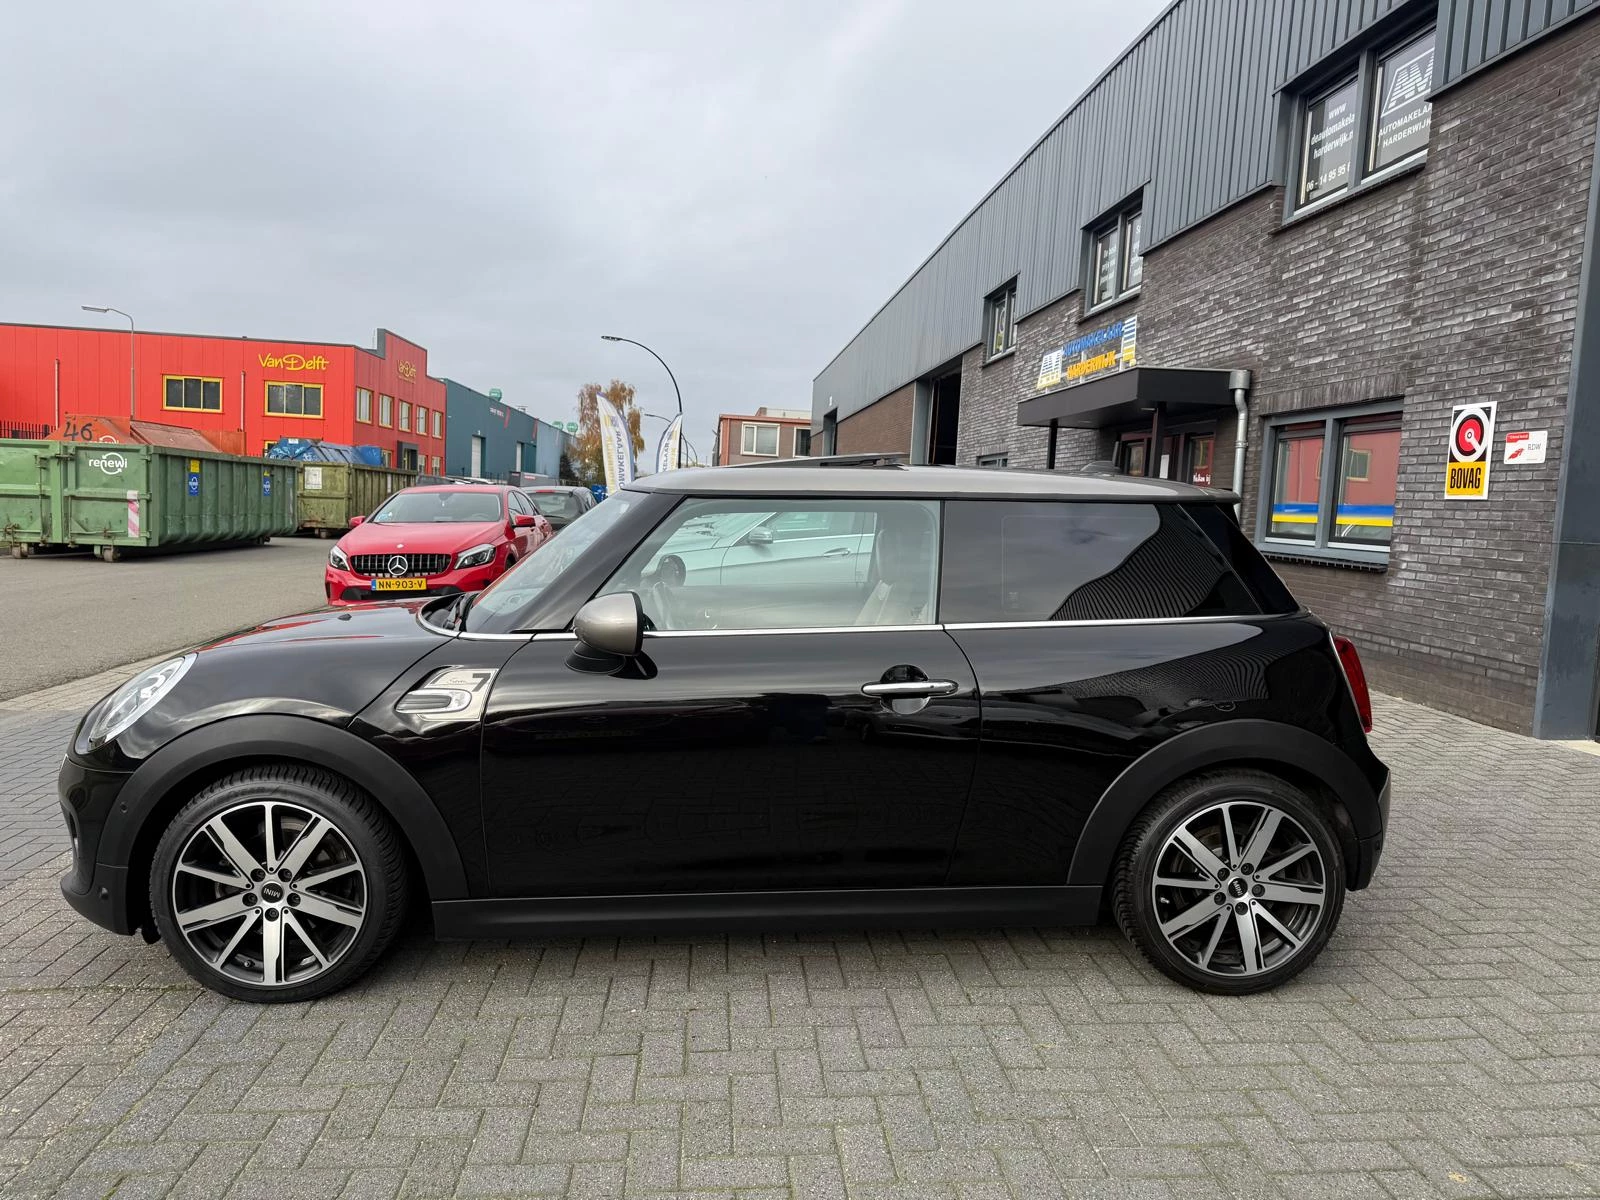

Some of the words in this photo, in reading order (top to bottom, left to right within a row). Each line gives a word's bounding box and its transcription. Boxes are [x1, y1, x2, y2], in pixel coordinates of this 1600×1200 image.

[1328, 102, 1347, 120] www
[1320, 172, 1328, 185] 14
[1328, 166, 1337, 179] 95
[1337, 162, 1346, 175] 95
[63, 421, 93, 441] 46
[88, 456, 128, 471] renewi
[1449, 467, 1482, 489] BOVAG
[378, 581, 423, 589] NN-903-V
[263, 887, 281, 899] MINI
